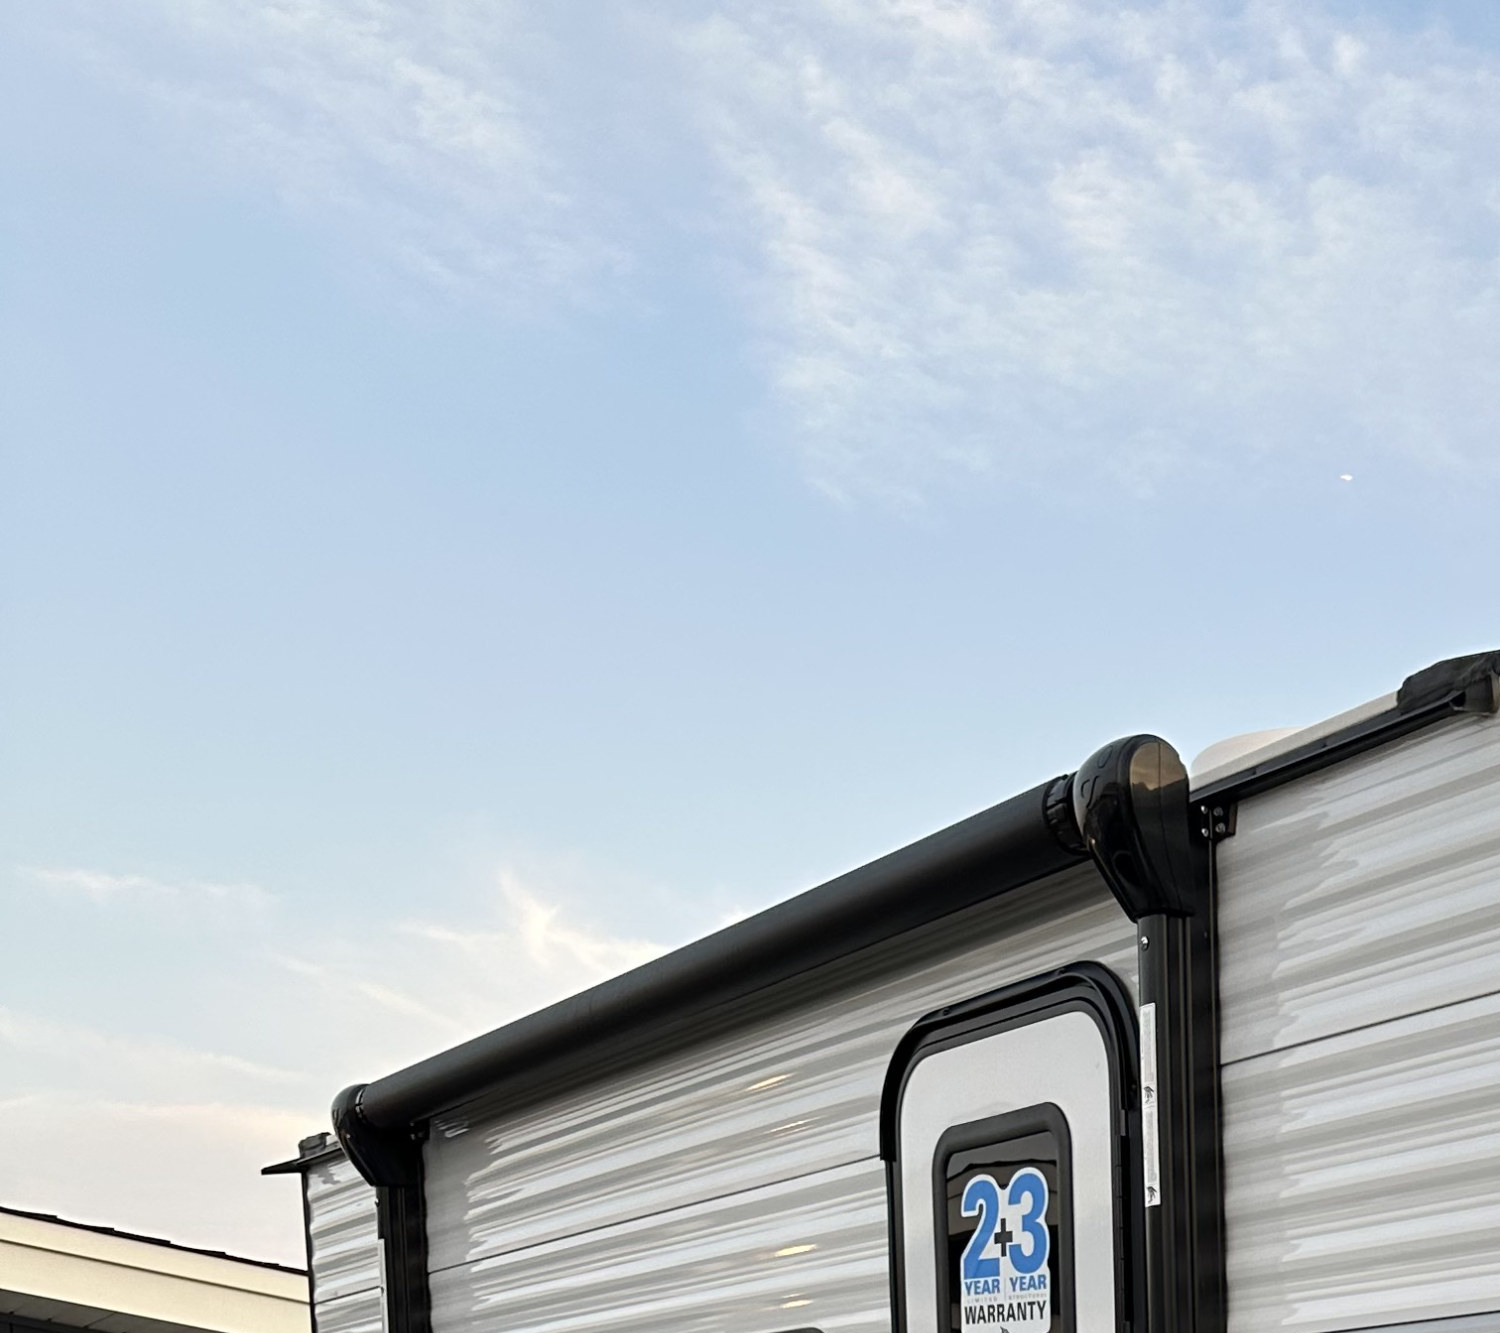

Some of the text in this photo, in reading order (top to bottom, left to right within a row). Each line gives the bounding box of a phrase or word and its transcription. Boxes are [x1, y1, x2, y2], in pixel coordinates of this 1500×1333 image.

[964, 1274, 1047, 1296] YEAR YEAR
[964, 1300, 1047, 1325] WARRANTY
